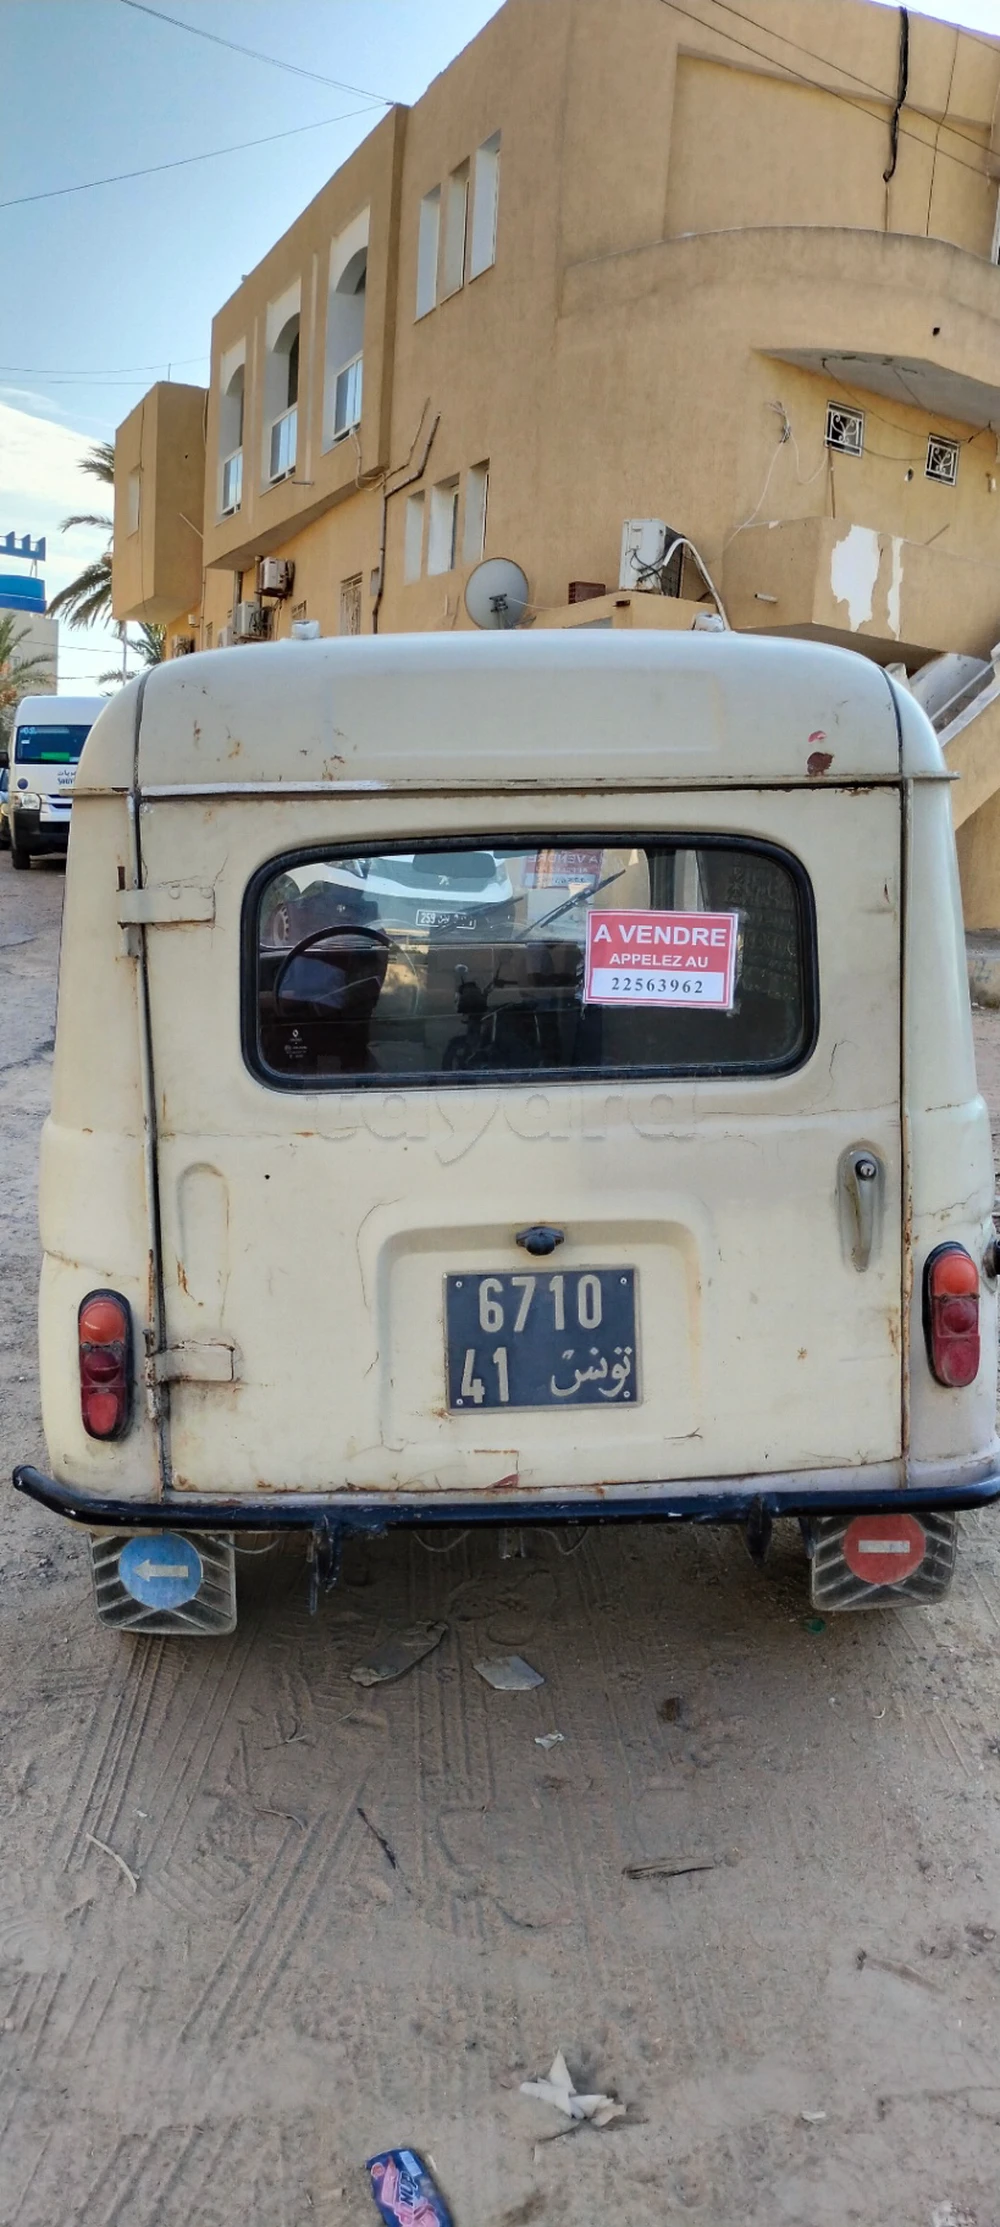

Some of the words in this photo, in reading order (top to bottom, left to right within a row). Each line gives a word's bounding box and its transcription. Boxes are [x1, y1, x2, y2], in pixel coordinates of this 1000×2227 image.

[420, 912, 436, 924] 259
[594, 924, 612, 943] A
[618, 925, 727, 947] VENDRE
[609, 953, 682, 967] APPELEZ
[685, 956, 709, 968] AU
[611, 977, 703, 994] 22563962
[479, 1274, 603, 1333] 6710
[461, 1347, 510, 1404] 41
[551, 1346, 633, 1398] تونس
